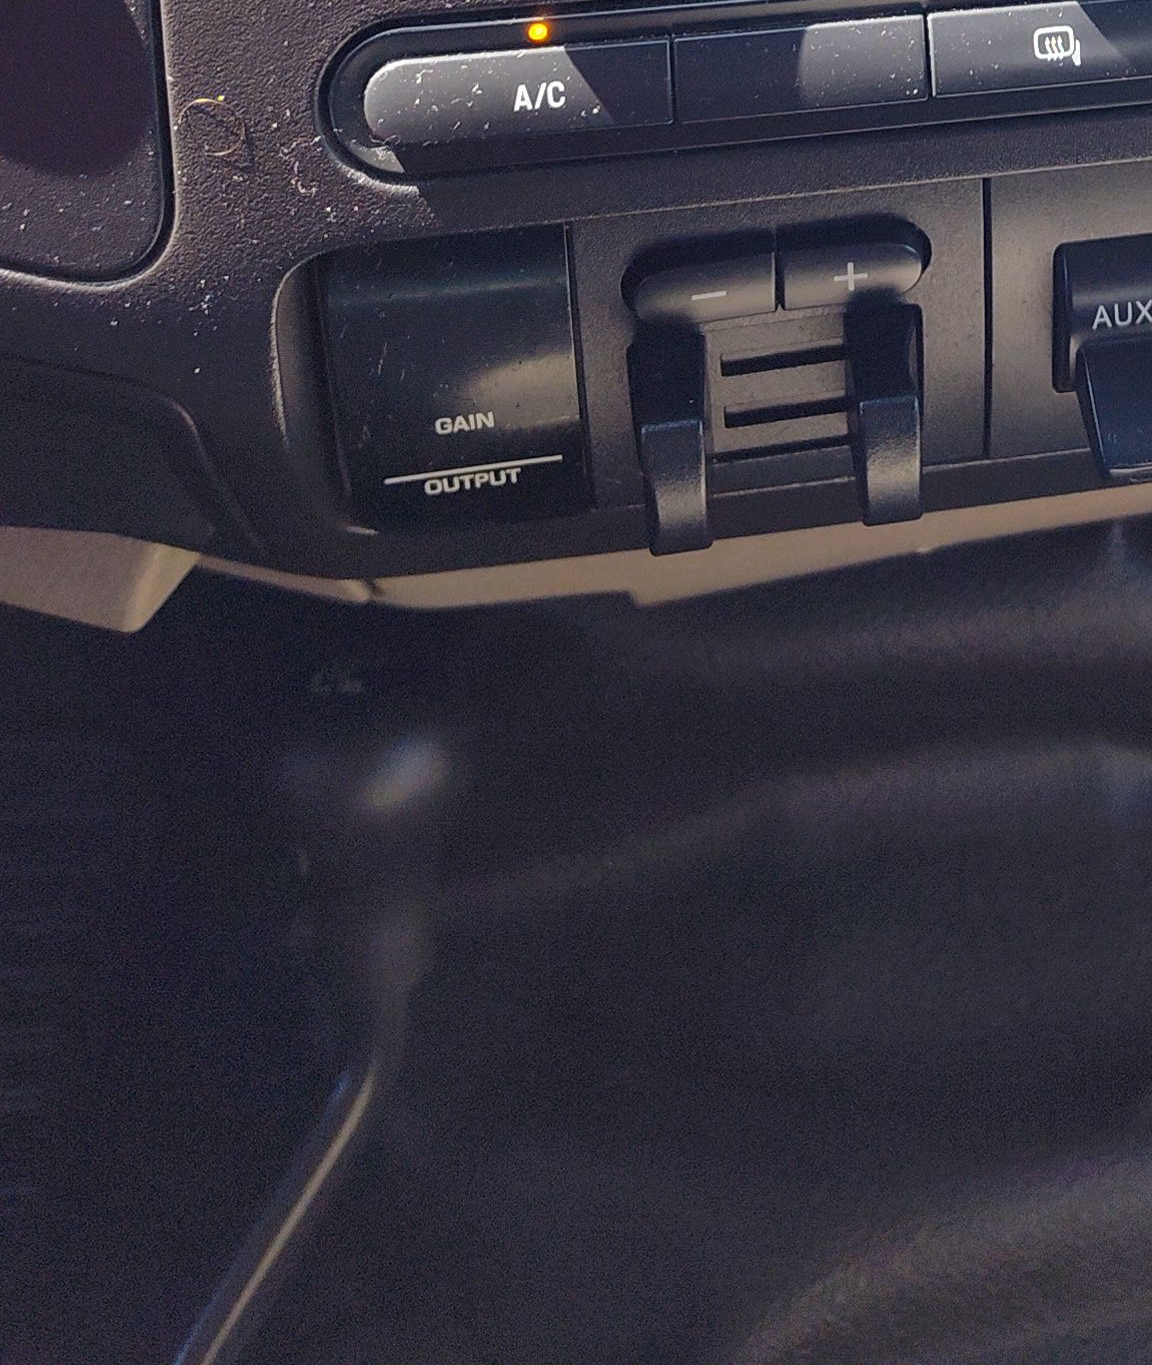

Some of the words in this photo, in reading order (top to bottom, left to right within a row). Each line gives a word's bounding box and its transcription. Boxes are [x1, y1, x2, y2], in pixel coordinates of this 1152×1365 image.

[513, 81, 567, 113] A/C
[435, 411, 494, 435] GAIN
[424, 468, 521, 495] OUTPUT
